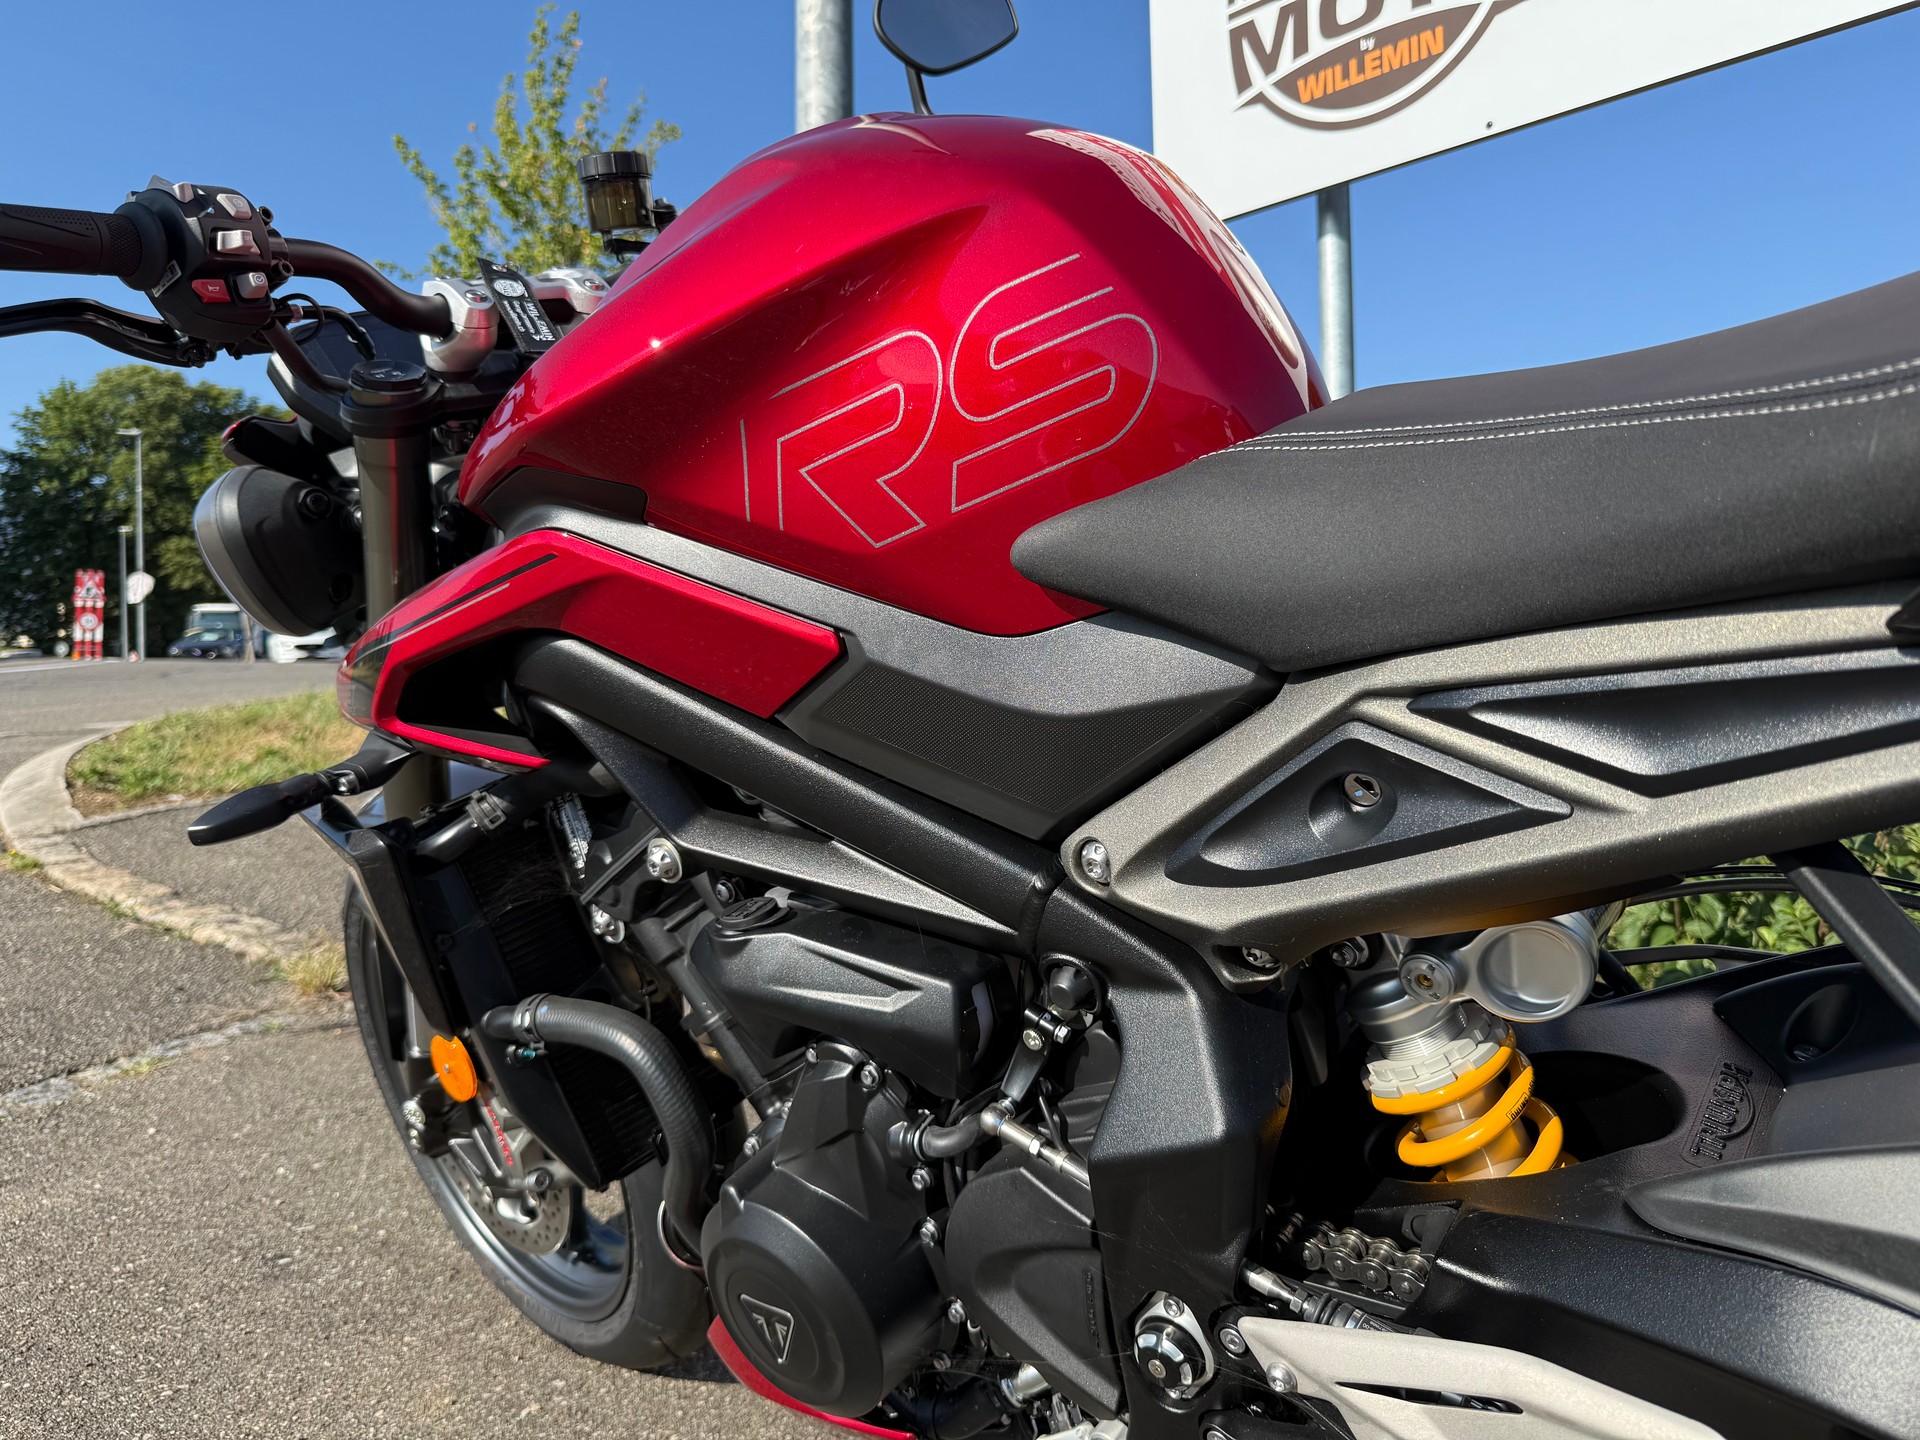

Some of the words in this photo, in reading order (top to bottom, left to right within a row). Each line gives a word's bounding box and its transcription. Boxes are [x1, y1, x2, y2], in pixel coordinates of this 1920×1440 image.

[1296, 25, 1444, 104] WILLEMIN
[1359, 36, 1376, 51] by
[740, 253, 1158, 548] RS
[1690, 1062, 1753, 1160] TRIUMPH
